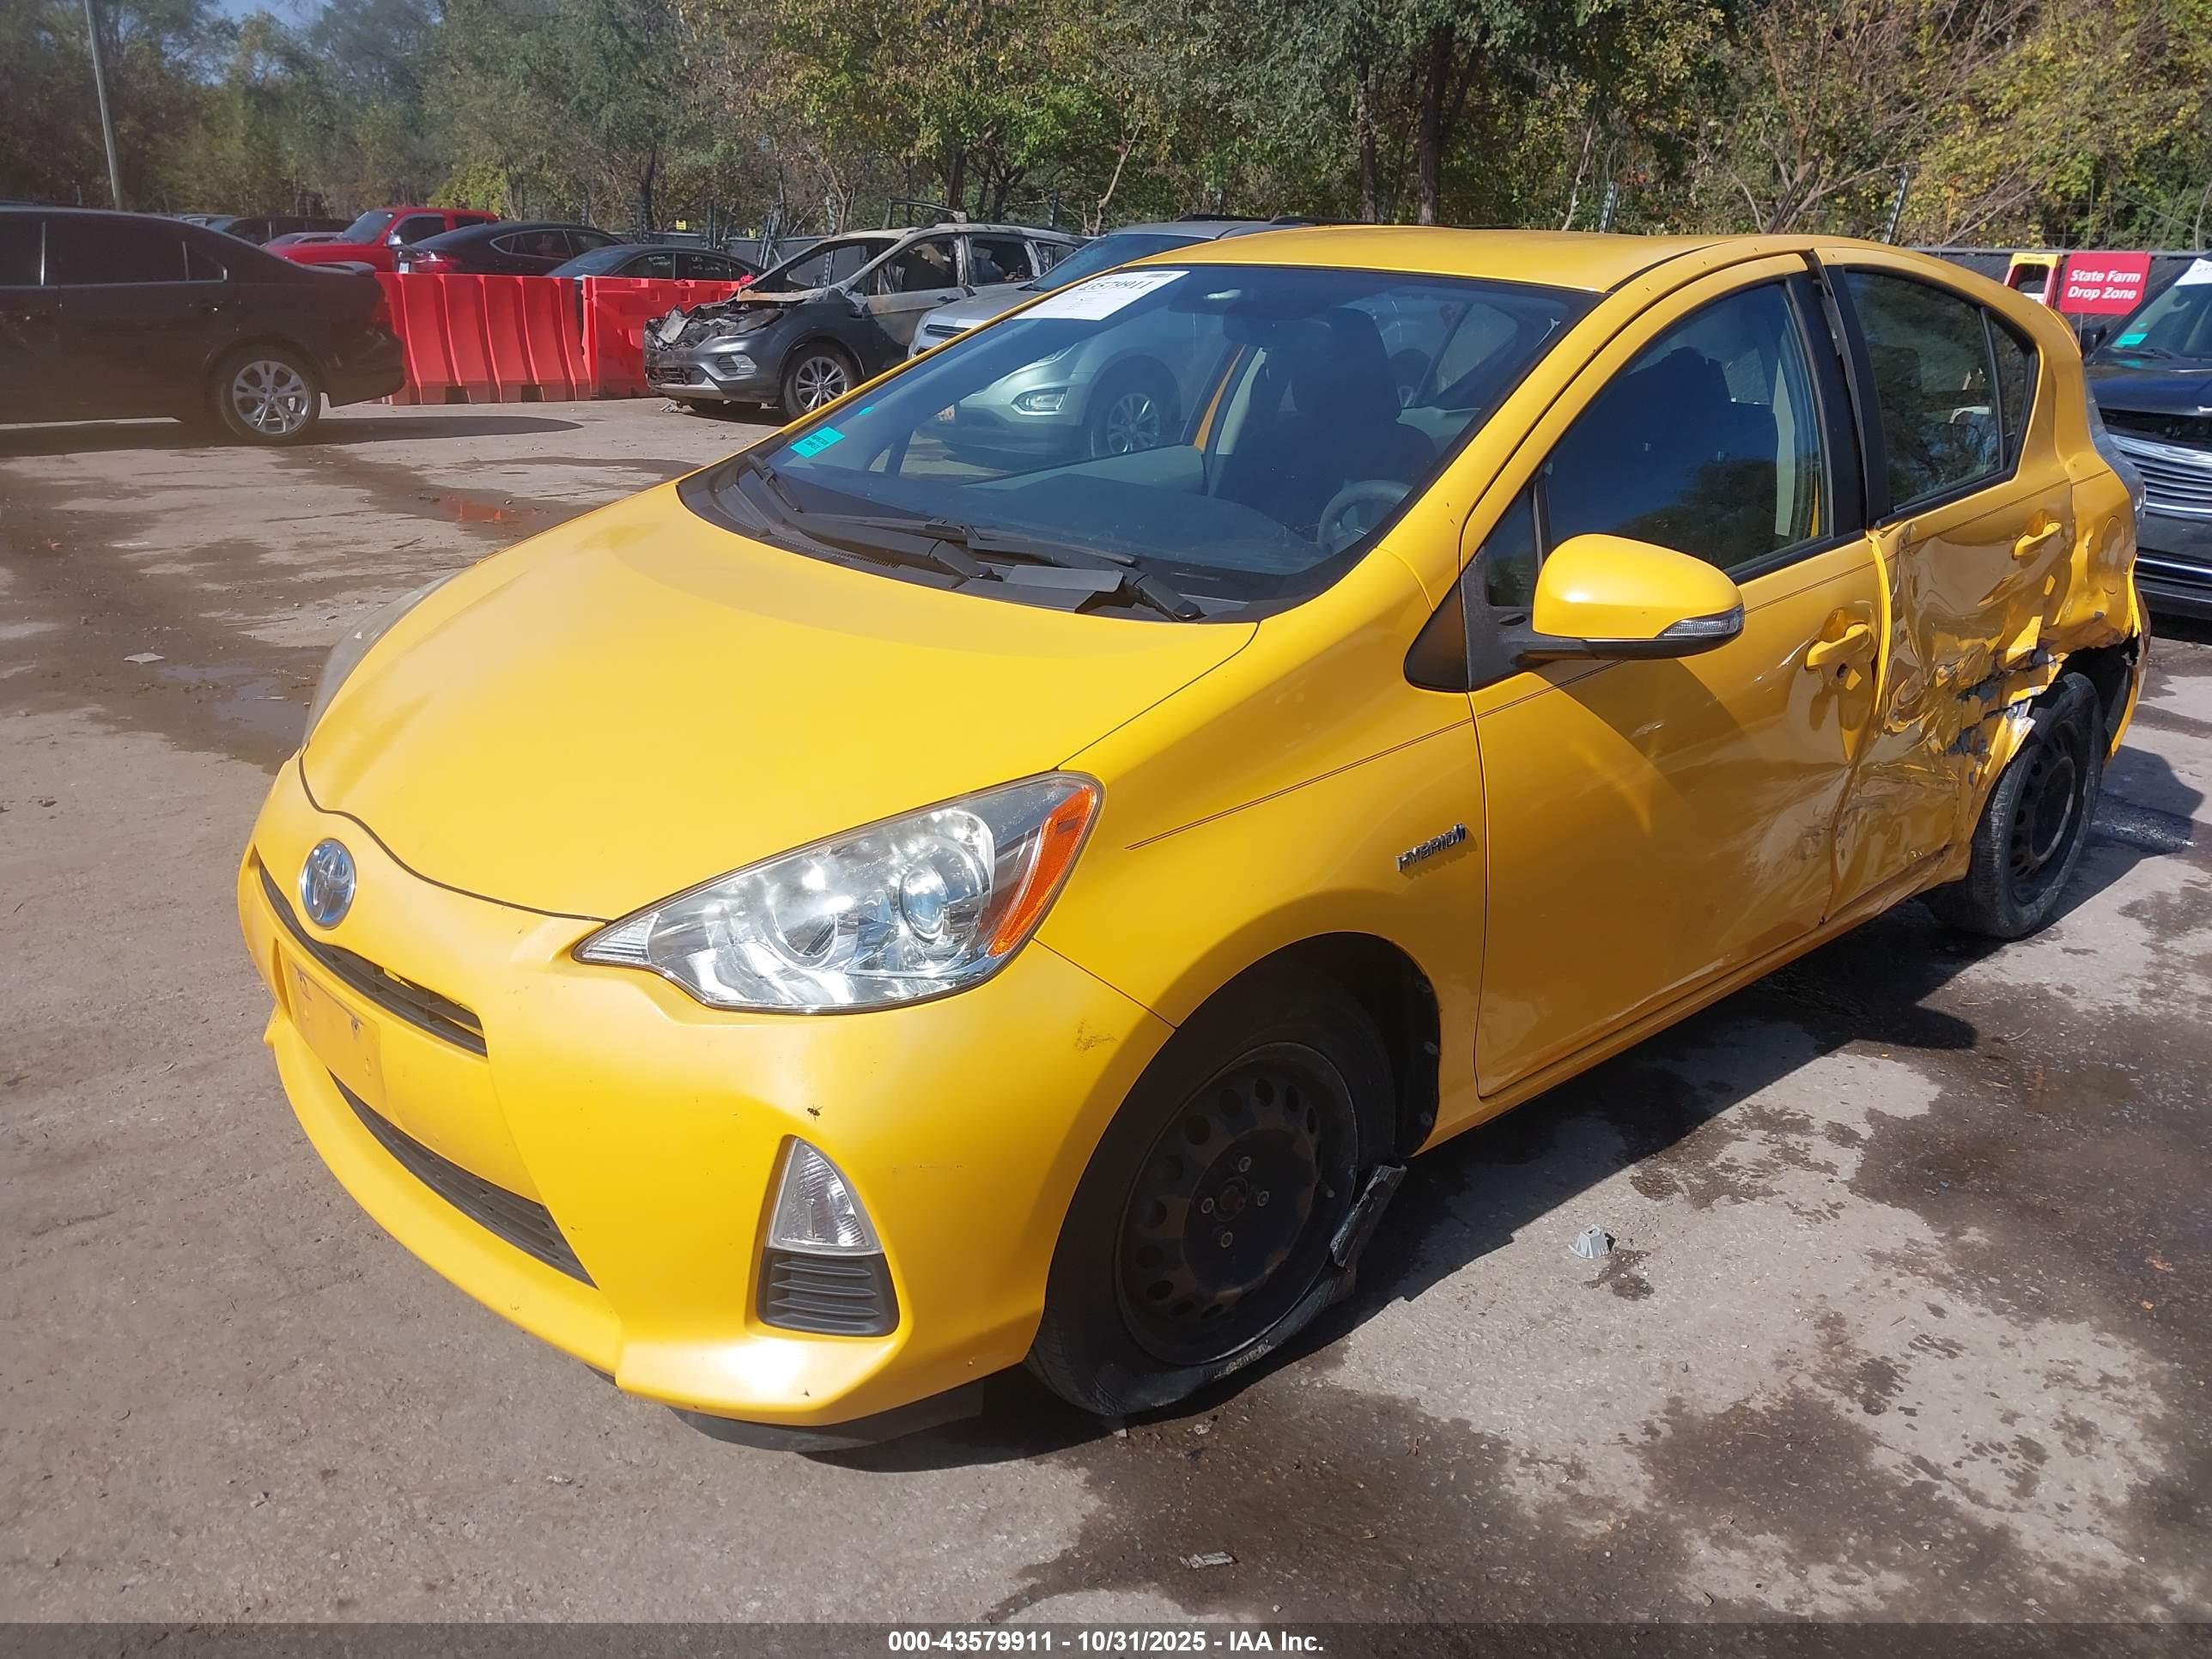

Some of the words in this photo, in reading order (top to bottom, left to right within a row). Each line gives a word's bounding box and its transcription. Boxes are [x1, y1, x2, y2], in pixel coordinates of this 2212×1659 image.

[2070, 270, 2105, 282] State
[2106, 270, 2141, 283] Farm
[2068, 286, 2100, 301] Drop
[2102, 287, 2136, 299] Zone
